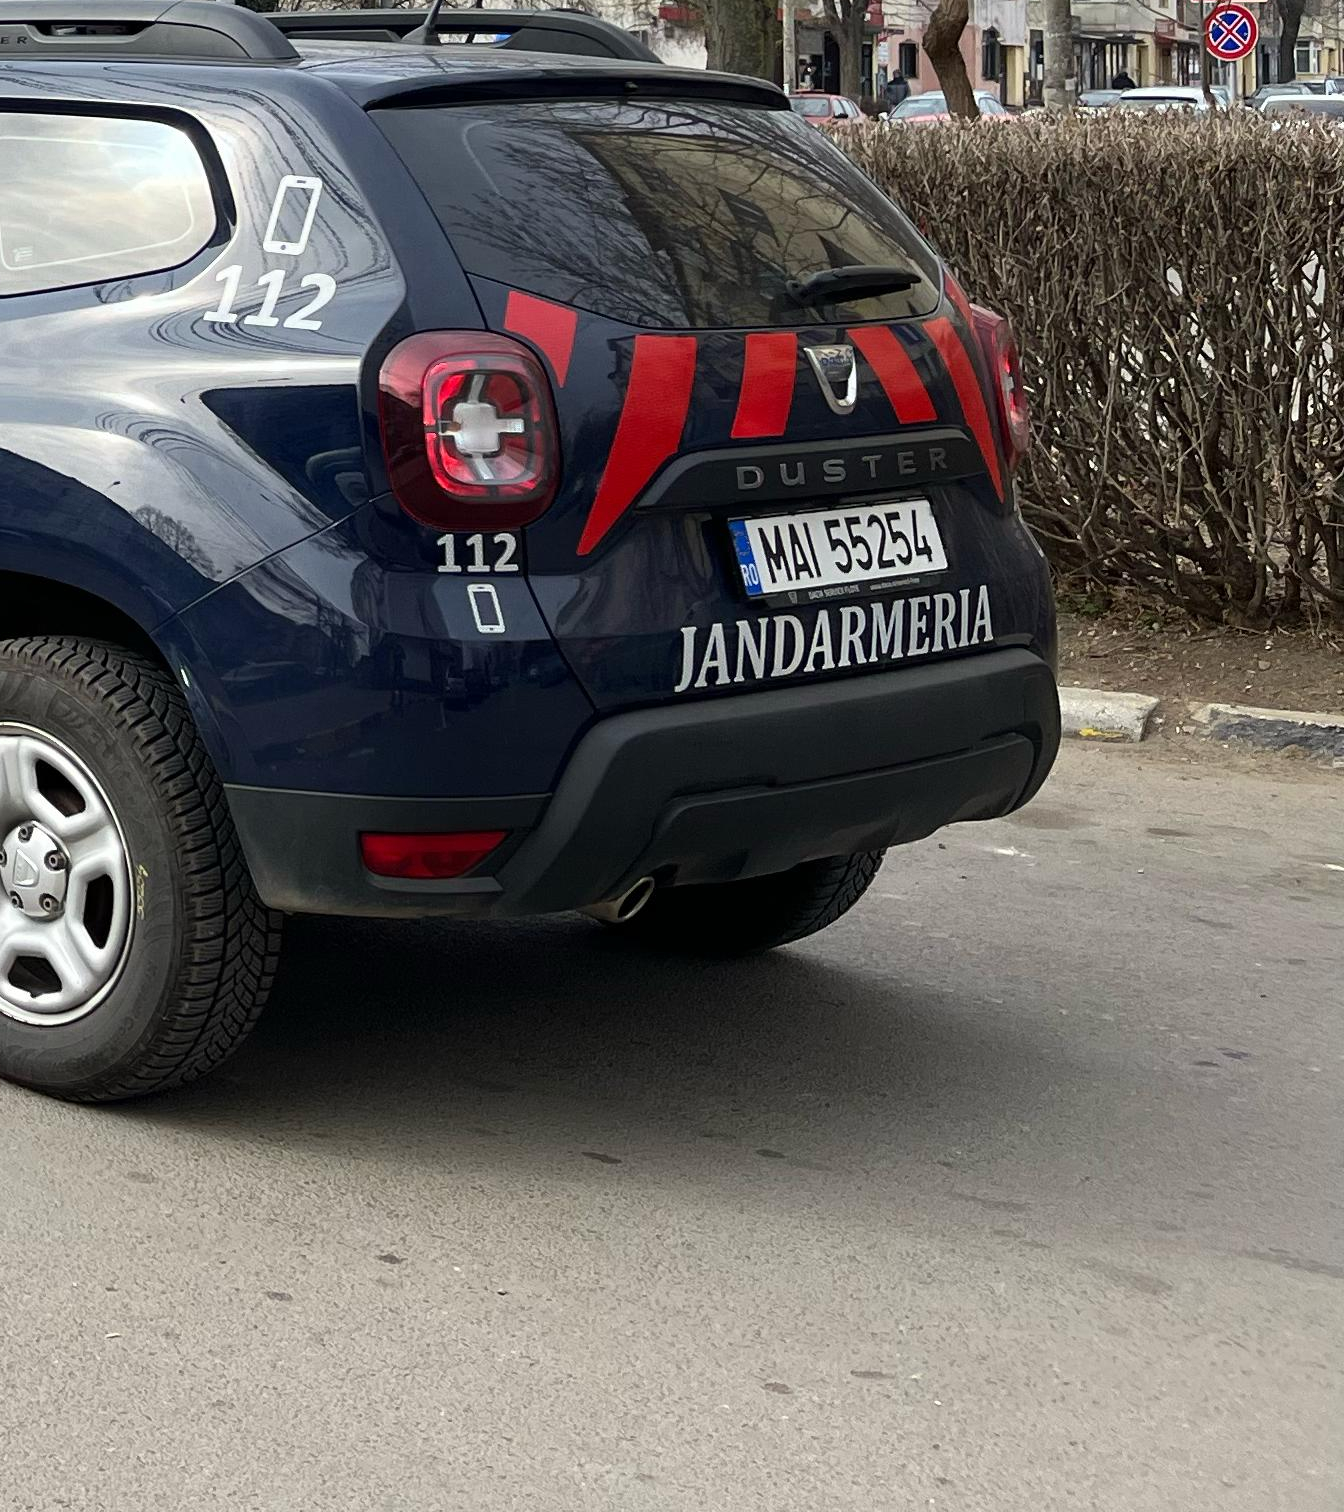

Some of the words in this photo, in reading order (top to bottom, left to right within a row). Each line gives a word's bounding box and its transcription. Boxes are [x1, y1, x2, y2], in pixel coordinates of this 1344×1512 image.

[203, 265, 337, 330] 112
[736, 448, 948, 489] DUSTER
[437, 533, 519, 572] 112
[741, 564, 760, 586] RO
[758, 522, 822, 584] MAI
[824, 510, 933, 574] 55254
[674, 585, 994, 693] JANDARMERIA
